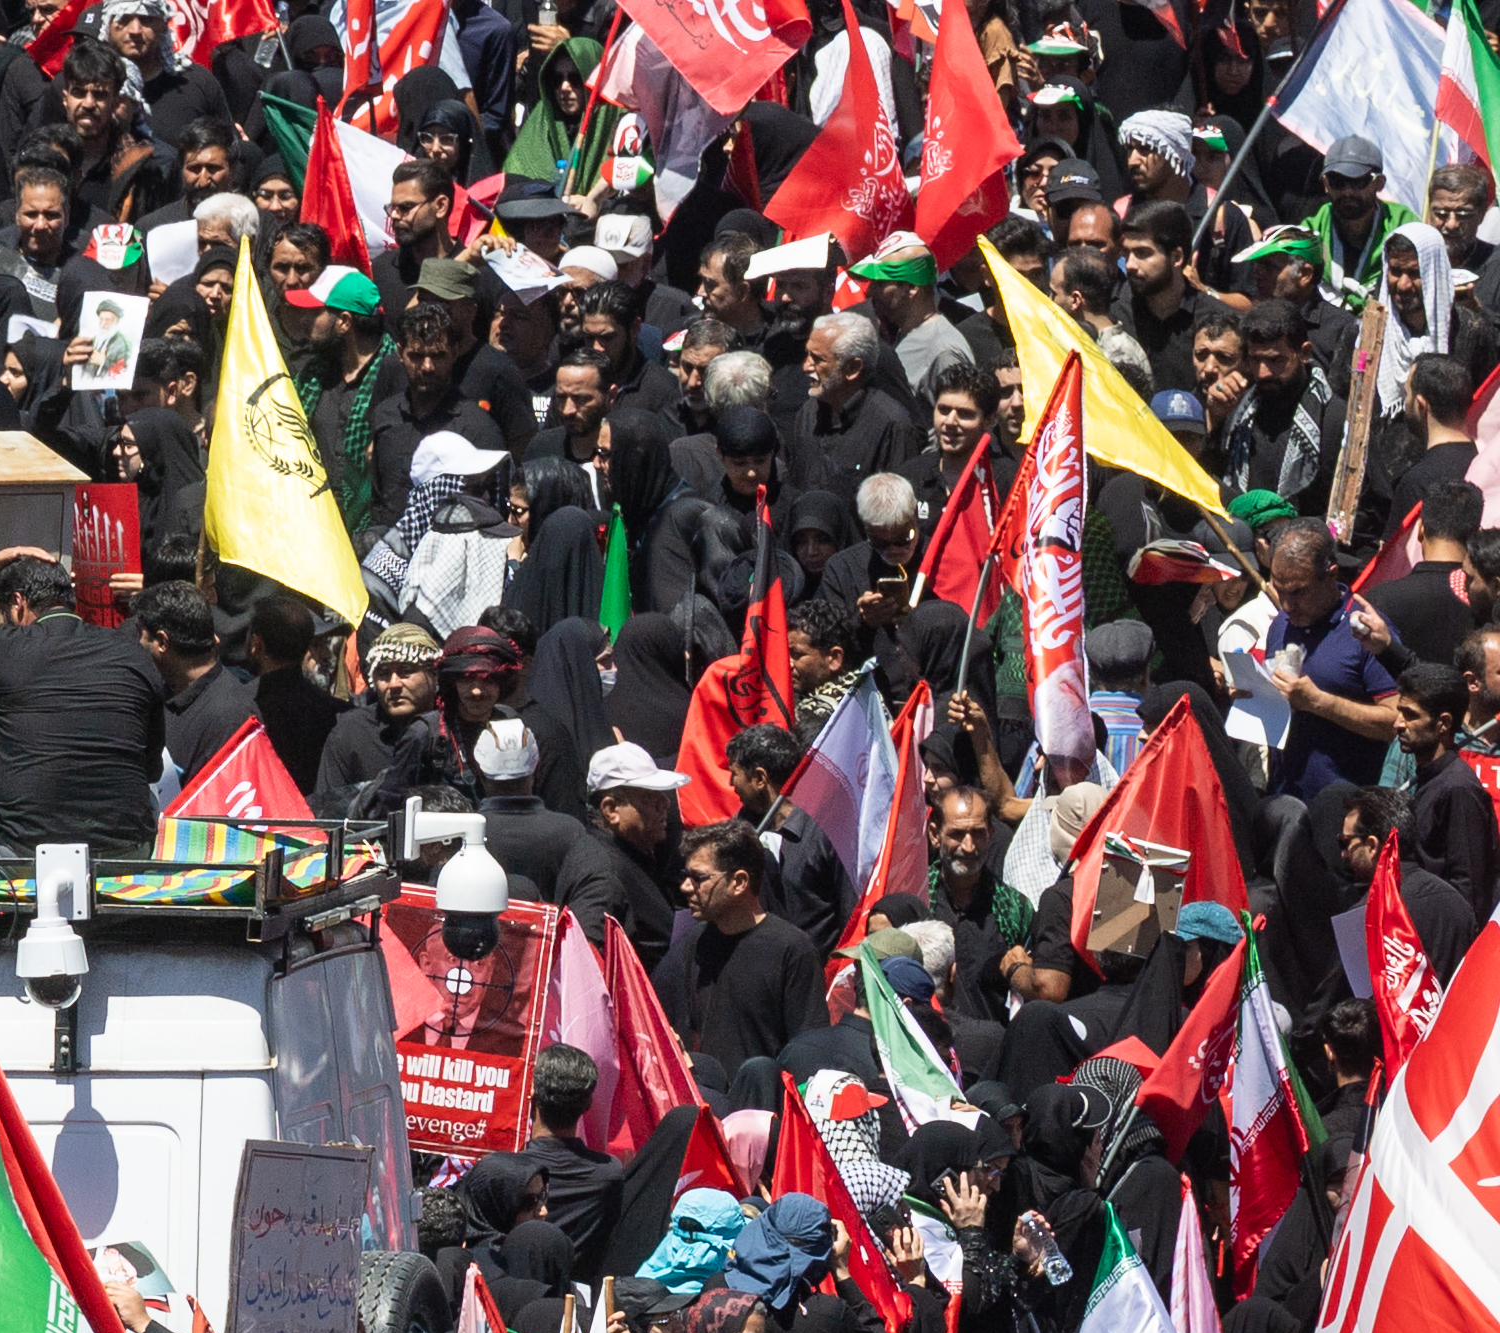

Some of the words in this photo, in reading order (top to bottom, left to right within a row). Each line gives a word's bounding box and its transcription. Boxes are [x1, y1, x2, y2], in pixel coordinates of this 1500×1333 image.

[406, 1053, 442, 1080] will
[442, 1057, 475, 1084] kill
[475, 1063, 510, 1089] you
[422, 1082, 494, 1114] bastard
[404, 1113, 487, 1143] evenge#
